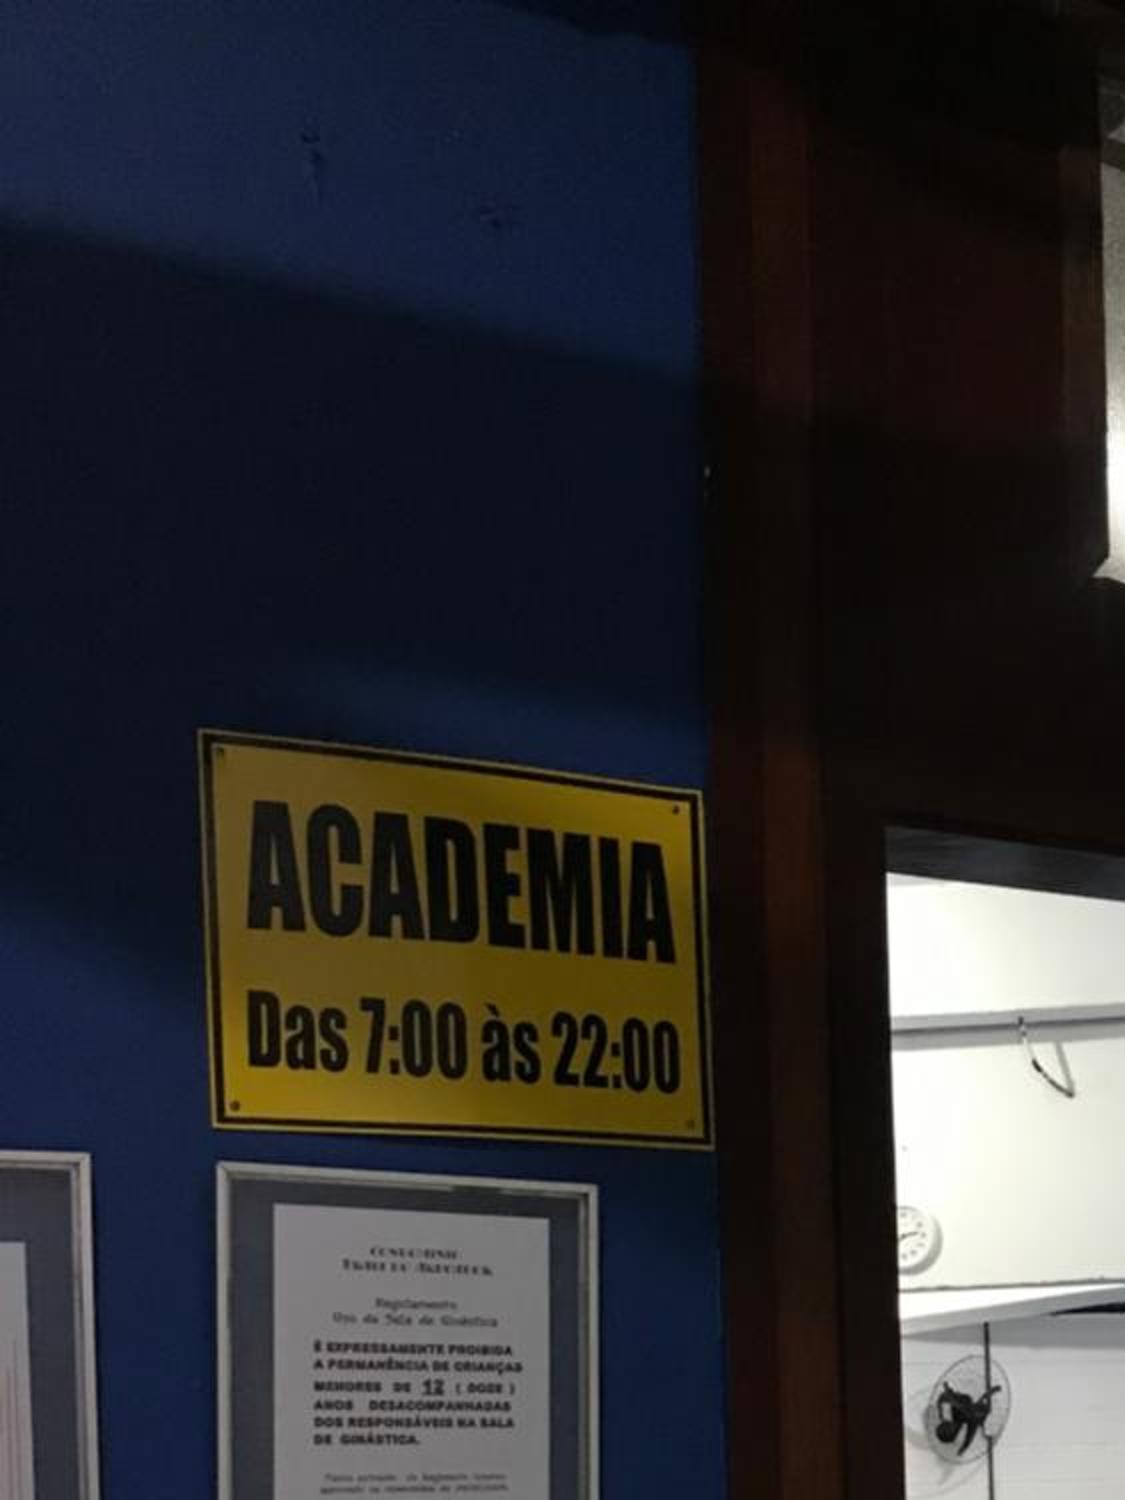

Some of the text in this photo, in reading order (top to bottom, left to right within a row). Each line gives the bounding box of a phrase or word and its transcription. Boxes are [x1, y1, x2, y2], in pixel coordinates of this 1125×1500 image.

[248, 800, 676, 964] ACADEMIA
[247, 990, 680, 1094] Das 7:00 às 22:00
[327, 1342, 444, 1355] EXPRESSAMENTE
[448, 1344, 512, 1356] PROIBIDA
[313, 1356, 523, 1375] A PERMANÊNCIA DE CRIANÇAS
[313, 1381, 382, 1393] MENORES
[393, 1382, 411, 1393] DE
[422, 1379, 445, 1396] 12
[313, 1400, 511, 1412] ANOS DESACOMPANHADAS
[313, 1415, 514, 1428] DOS RESPONSÁVEIS NA SALA
[313, 1434, 332, 1445] DE
